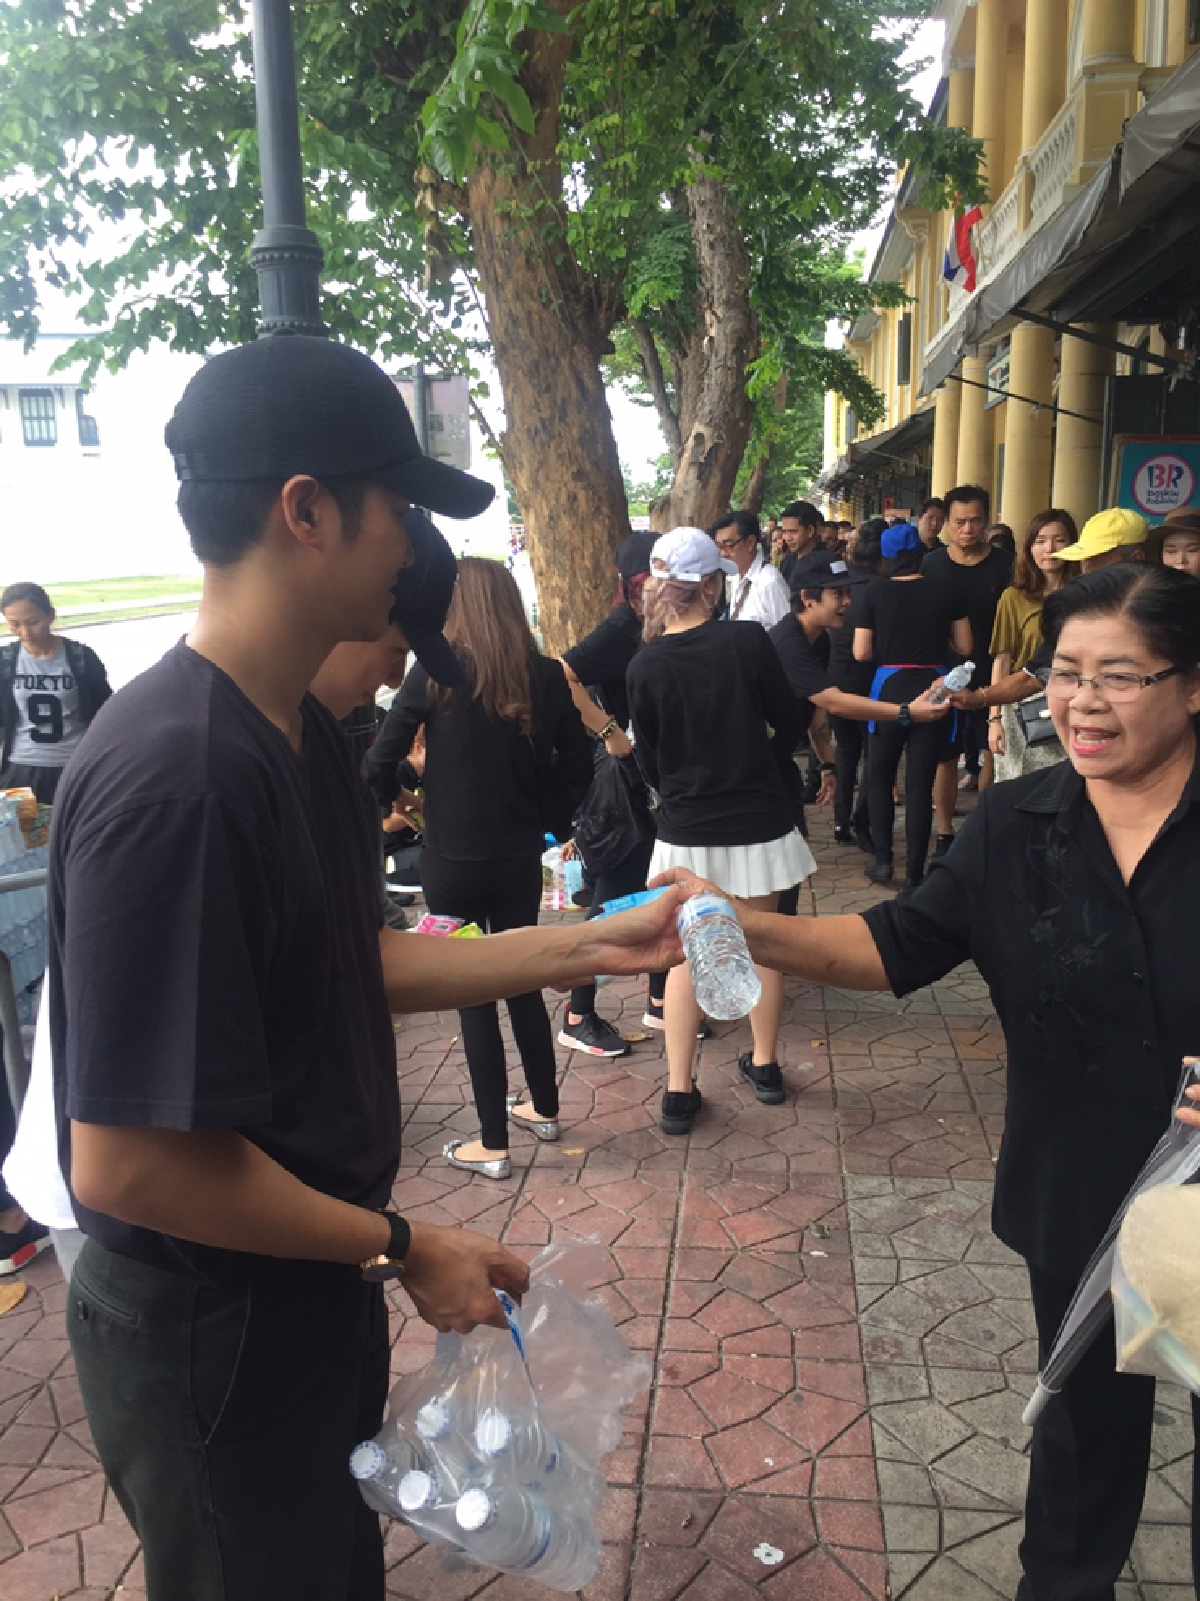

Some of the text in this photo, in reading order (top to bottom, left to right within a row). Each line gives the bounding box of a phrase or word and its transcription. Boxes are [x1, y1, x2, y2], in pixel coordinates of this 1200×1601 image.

[1147, 464, 1184, 488] BR
[14, 674, 75, 691] TOKYO
[27, 693, 63, 743] 9
